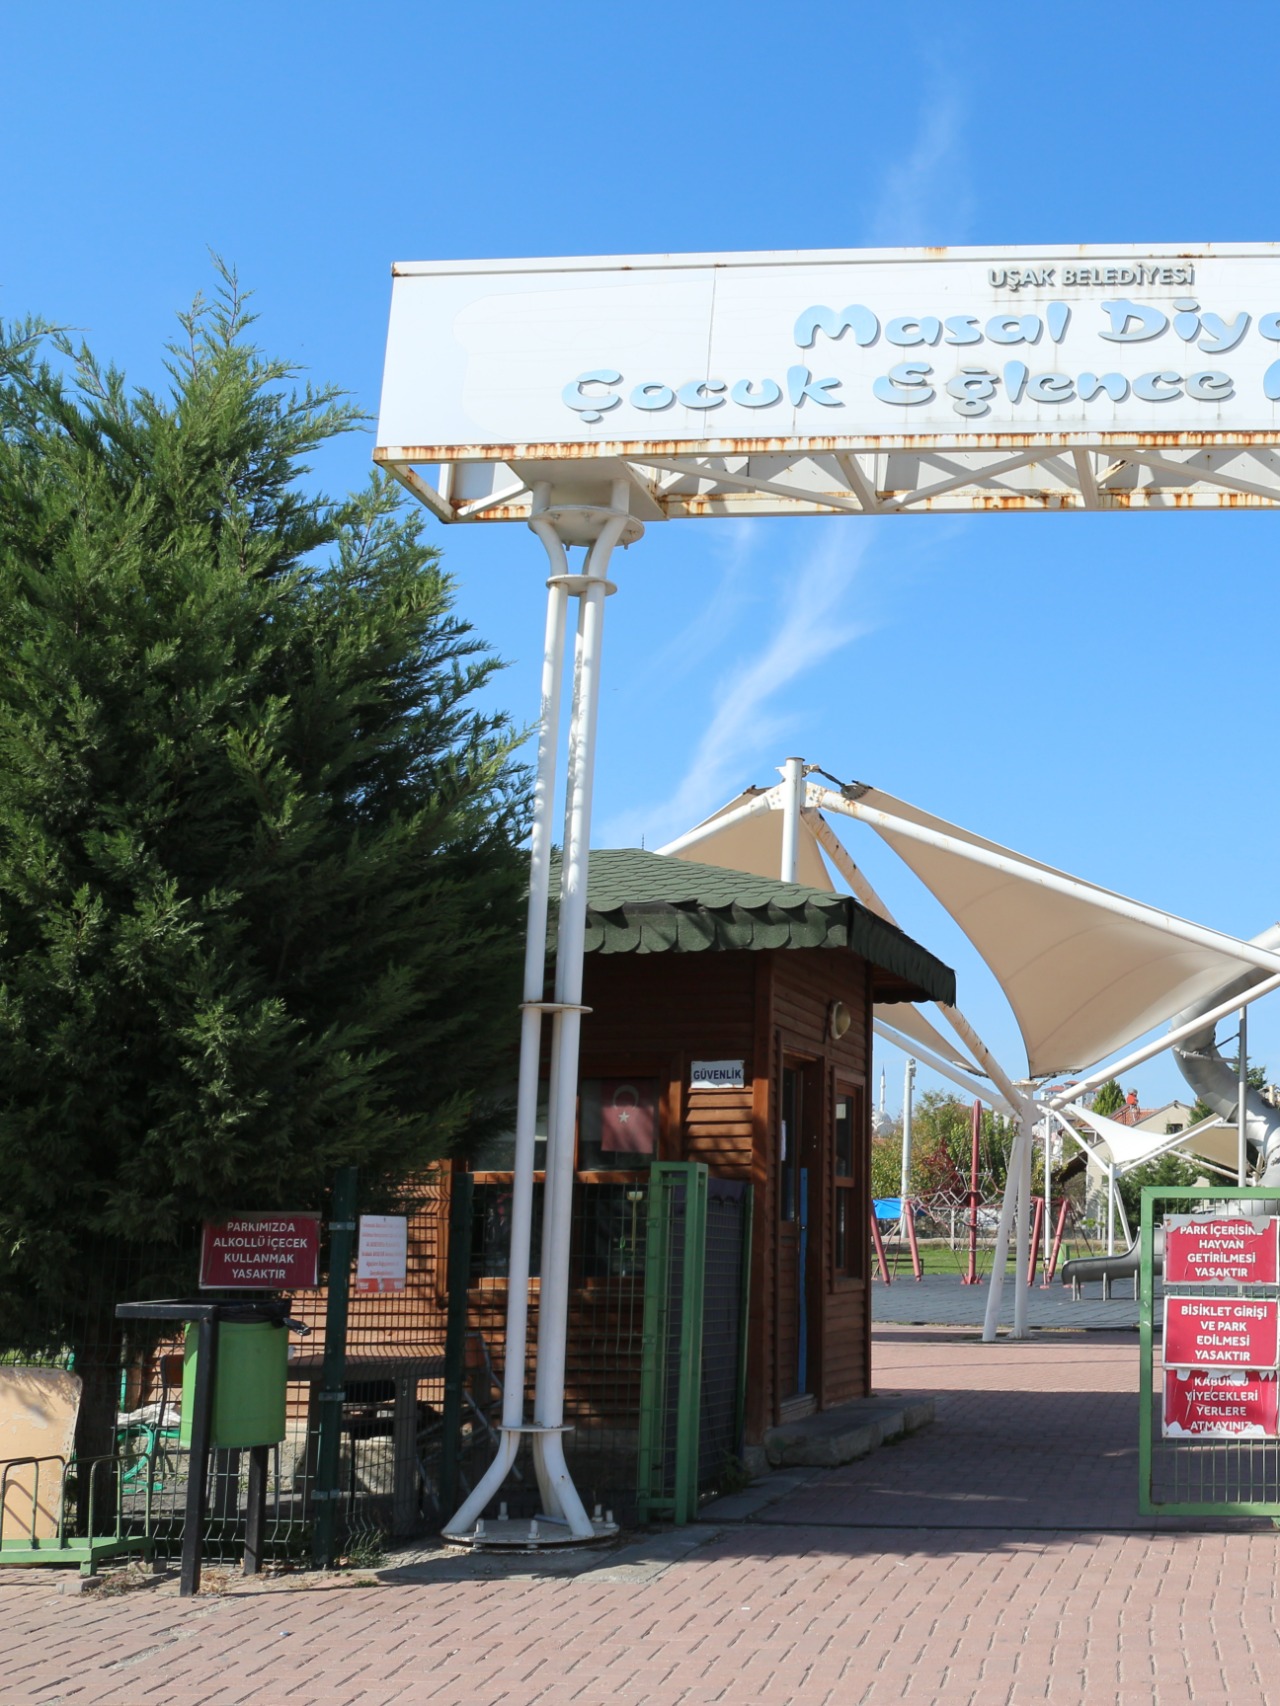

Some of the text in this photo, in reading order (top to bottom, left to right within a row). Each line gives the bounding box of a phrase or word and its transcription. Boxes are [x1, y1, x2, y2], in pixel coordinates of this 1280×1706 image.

[988, 262, 1194, 292] UŞAK BELEDİYESİ
[794, 302, 1071, 348] Masal
[562, 368, 843, 422] Çocuk
[872, 360, 1235, 417] Eğlence
[693, 1067, 742, 1080] GÜVENLİK
[227, 1222, 296, 1232] PARKIMIZDA
[1180, 1224, 1263, 1237] PARK İÇERİSİN
[214, 1235, 308, 1250] ALKOLLÜ İÇECEK
[1199, 1240, 1244, 1249] HAYVAN
[224, 1254, 294, 1264] KULLANMAK
[1187, 1252, 1256, 1263] GETİRİLMESİ
[232, 1268, 286, 1278] YASAKTIR
[1195, 1268, 1248, 1277] YASAKTIR
[1181, 1304, 1268, 1320] BİSİKLET GİRİŞİ
[1200, 1321, 1247, 1332] VE PARK
[1196, 1334, 1250, 1346] EDİLMESİ
[1195, 1350, 1250, 1361] YASAKTIR
[1194, 1376, 1249, 1386] KABUKU
[1185, 1389, 1258, 1401] YİYECEKLERİ
[1196, 1406, 1246, 1416] YERLERE
